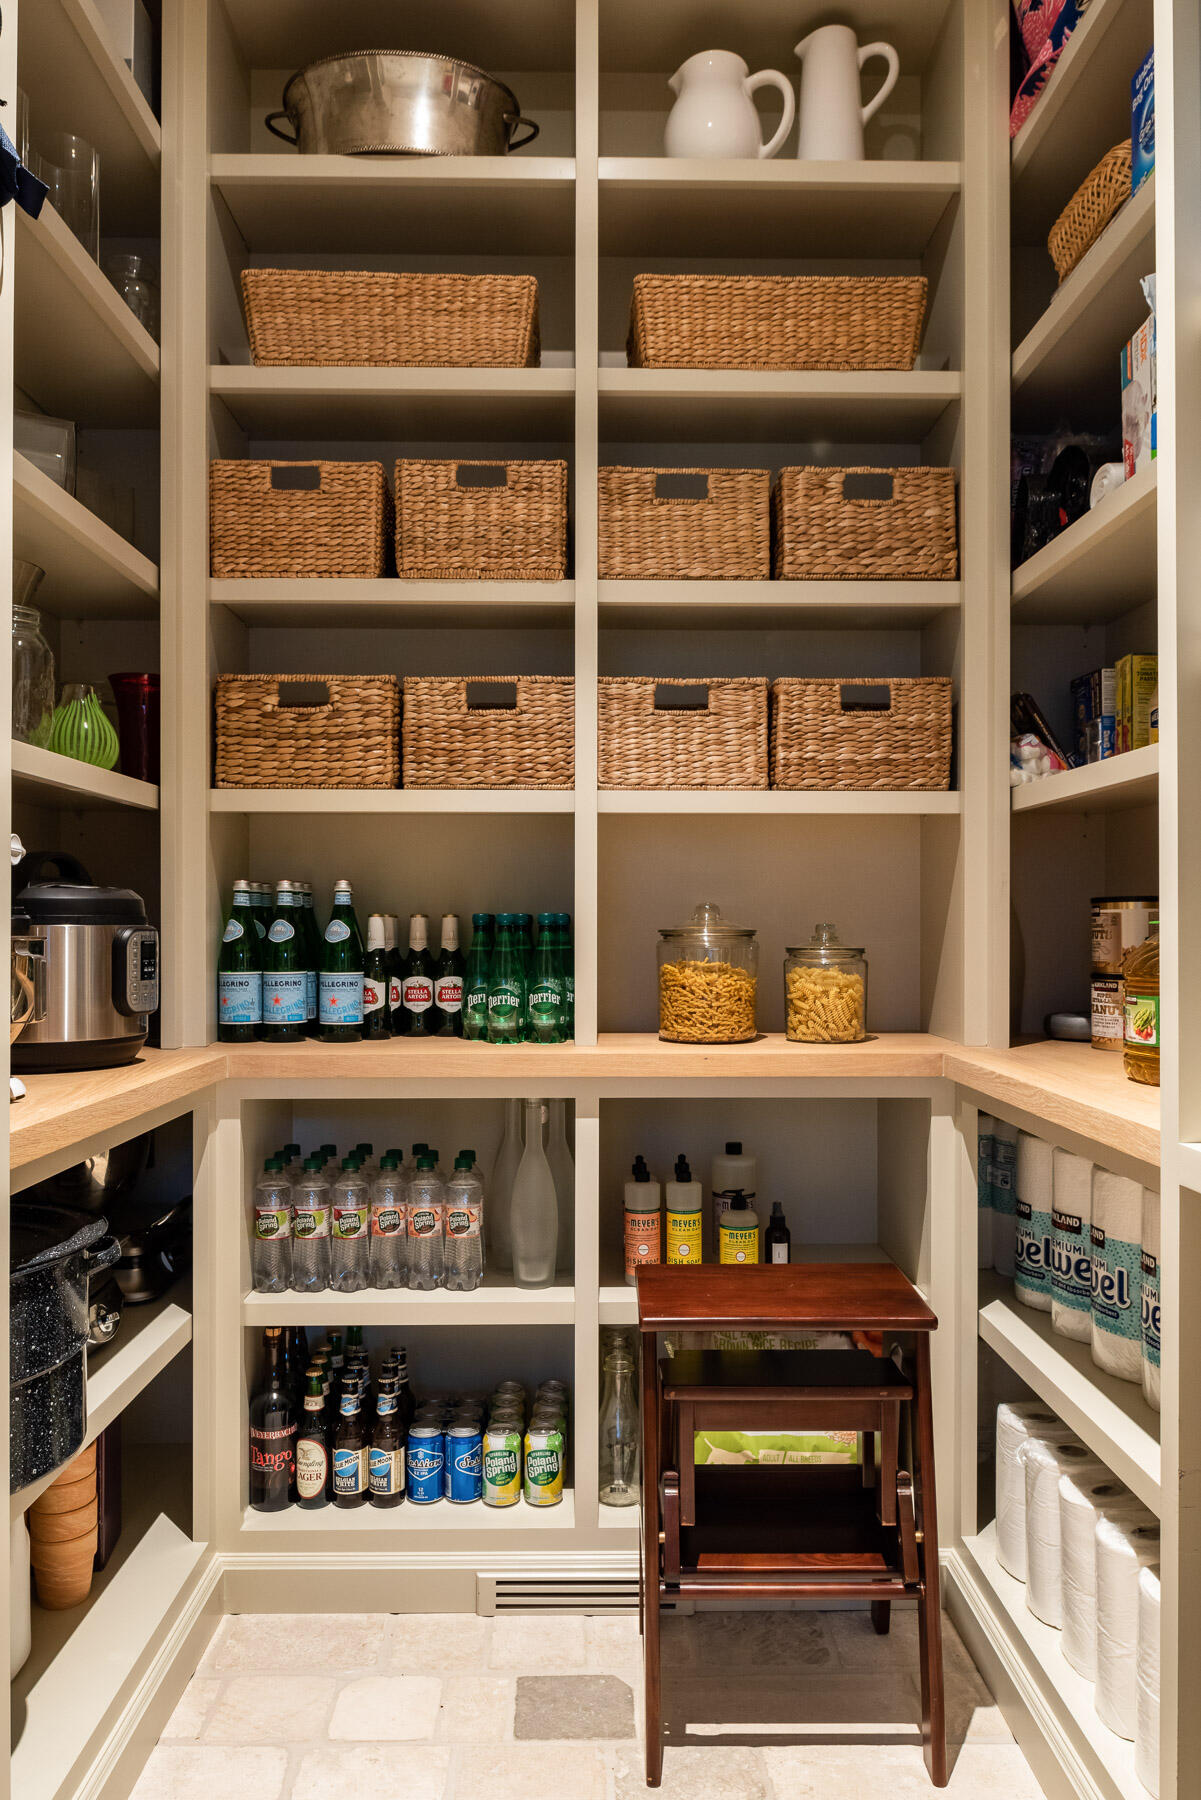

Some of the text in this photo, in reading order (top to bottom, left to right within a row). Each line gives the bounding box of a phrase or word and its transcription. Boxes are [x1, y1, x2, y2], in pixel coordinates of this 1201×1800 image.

[258, 1217, 277, 1225] Poland
[339, 1216, 359, 1225] Poland
[379, 1212, 399, 1222] Poland
[414, 1213, 434, 1223] Poland
[450, 1215, 468, 1223] Poland
[259, 1222, 278, 1231] Spring
[297, 1222, 315, 1231] Spring
[340, 1222, 360, 1232] Spring
[380, 1219, 400, 1228] Spring
[415, 1220, 434, 1229] Spring
[450, 1221, 469, 1229] Spring
[672, 1218, 701, 1228] MEYER'S
[729, 1231, 756, 1240] MEYER'S
[251, 1446, 293, 1471] Tango
[344, 1455, 360, 1467] MOON
[377, 1456, 392, 1465] MOON
[486, 1452, 515, 1467] Poland
[528, 1452, 557, 1467] Poland
[486, 1463, 516, 1478] Spring
[528, 1463, 558, 1478] Spring
